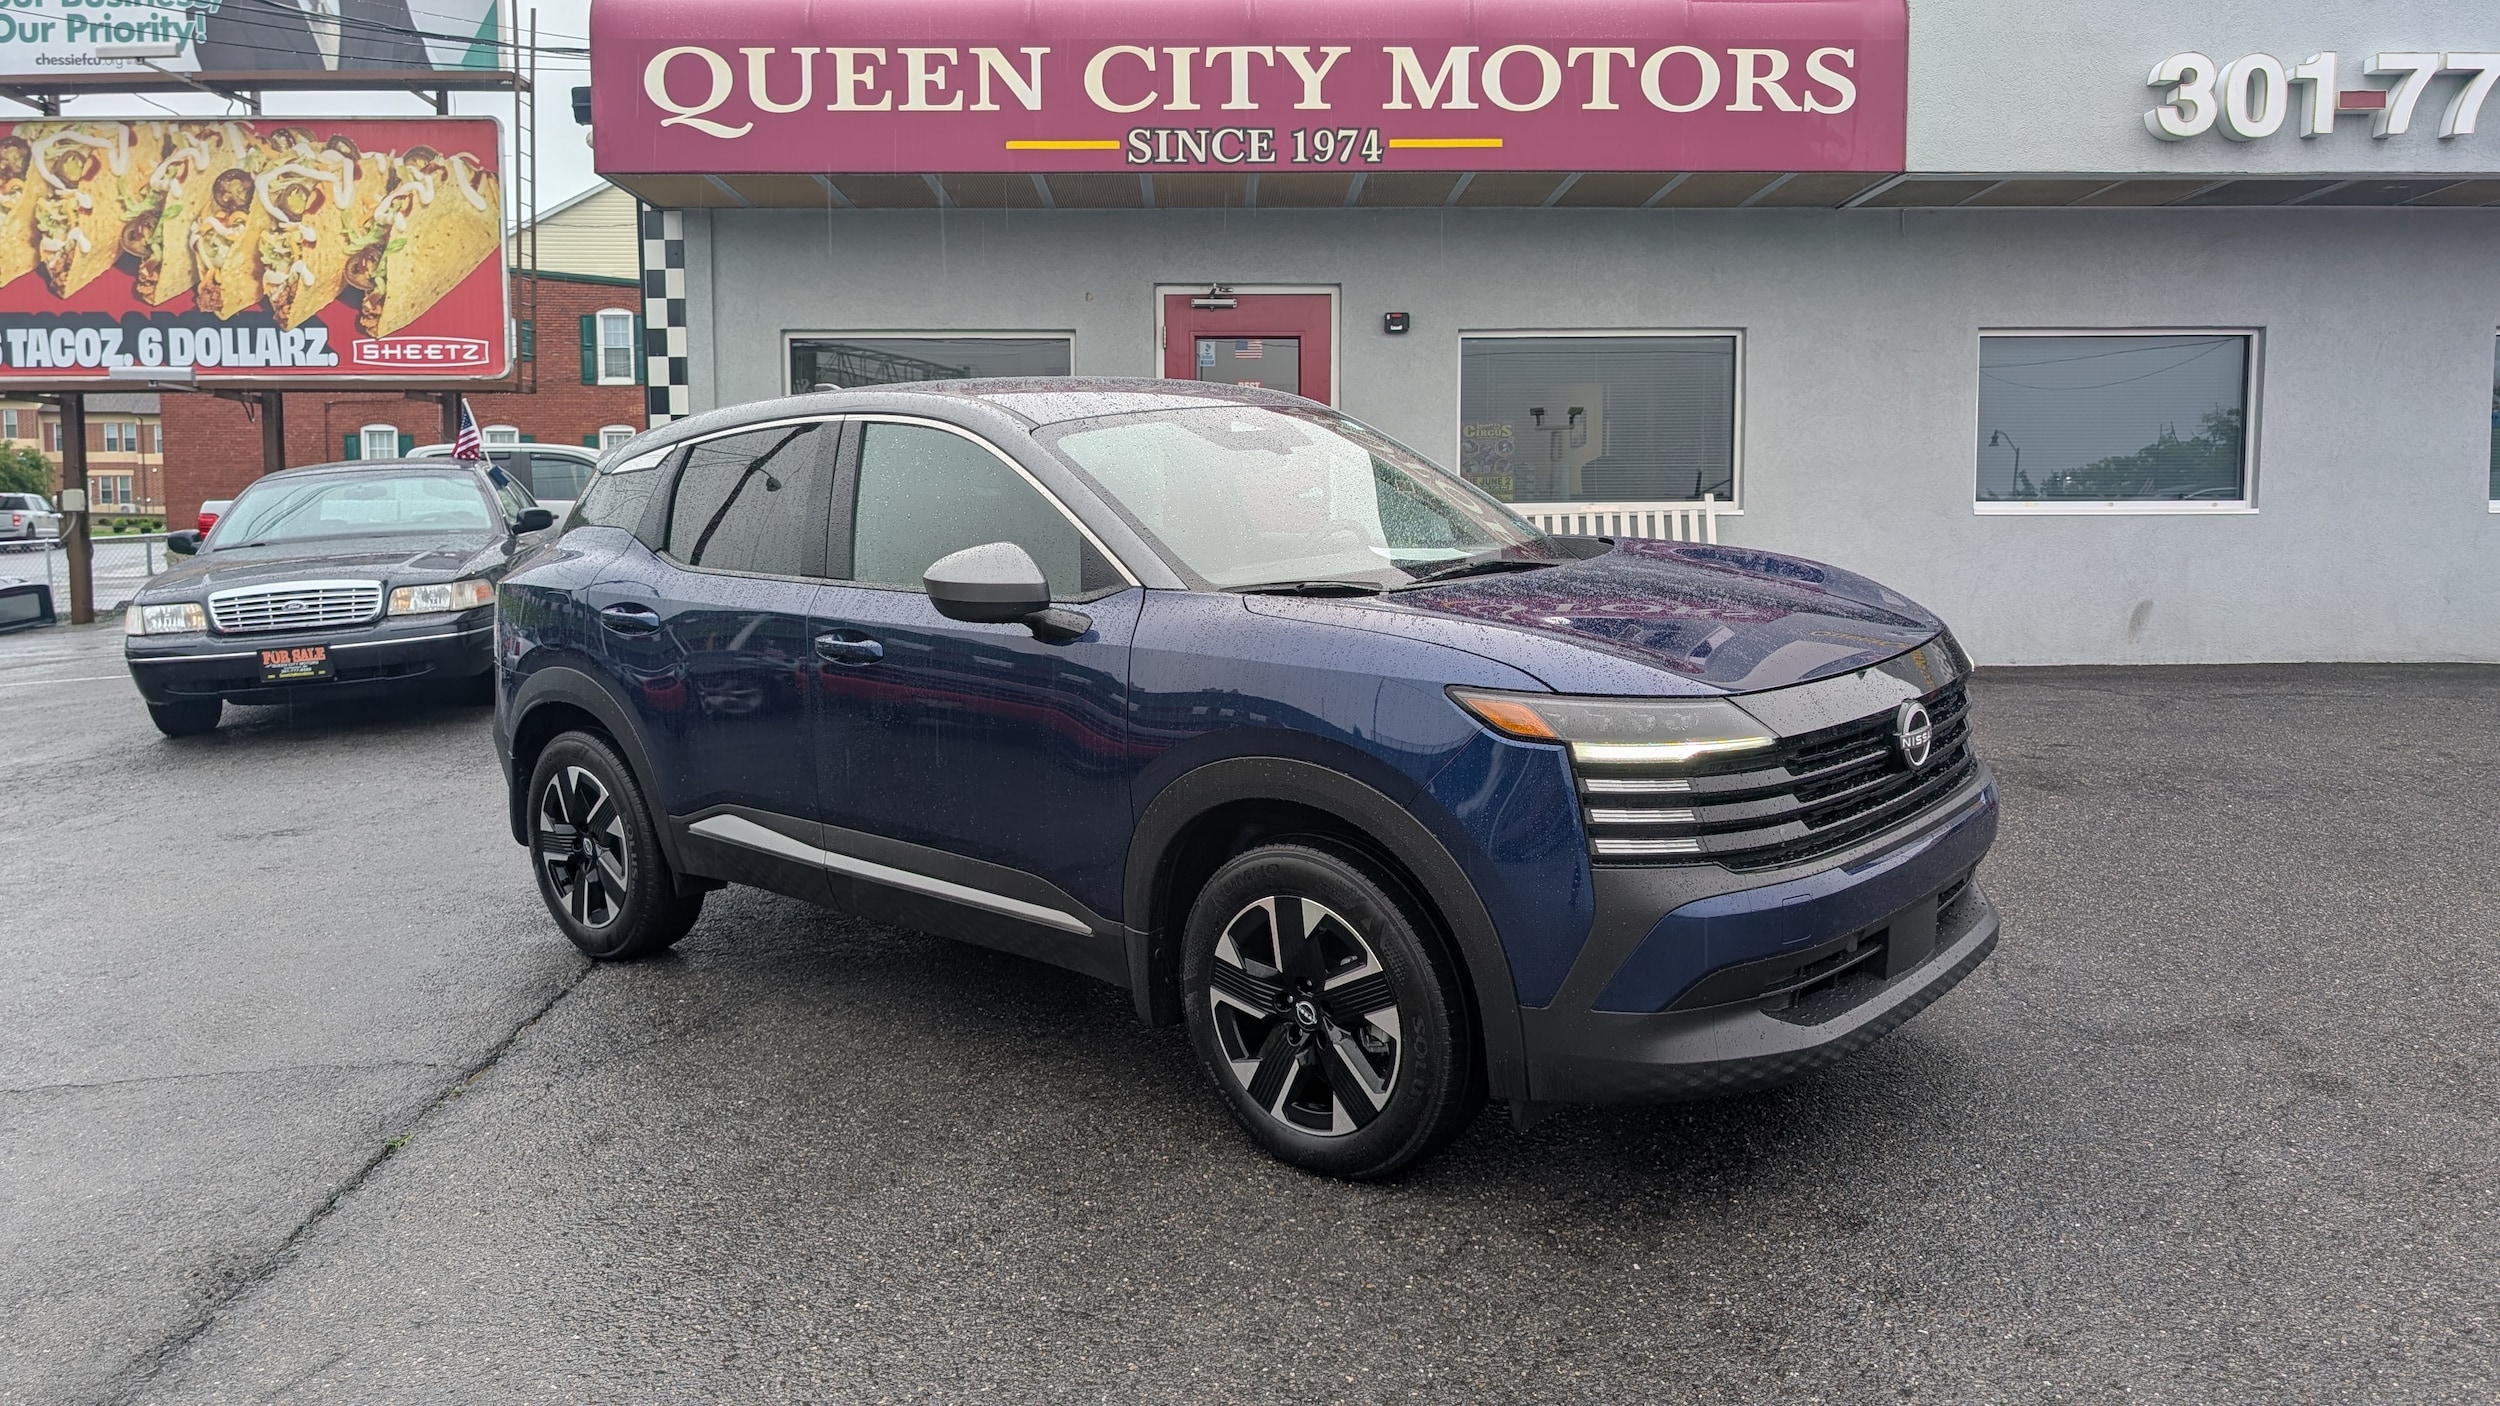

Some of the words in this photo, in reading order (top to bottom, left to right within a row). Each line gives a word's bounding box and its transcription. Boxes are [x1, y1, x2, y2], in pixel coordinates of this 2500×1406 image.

[0, 13, 56, 43] Our
[66, 12, 207, 52] Priority!
[643, 46, 1051, 139] QUEEN
[1083, 45, 1351, 113] CITY
[1382, 44, 1857, 114] MOTORS
[2143, 51, 2500, 142] 301-77
[1126, 126, 1277, 165] SINCE
[1291, 126, 1384, 165] 1974
[6, 327, 135, 368] TACOZ.
[137, 327, 163, 367] 6
[168, 327, 339, 368] DOLLARZ.
[363, 344, 479, 360] SHEETZ
[1463, 424, 1513, 438] CIRCUS
[1480, 477, 1503, 486] JUNE
[1505, 477, 1511, 485] 2
[262, 650, 290, 665] FOR
[292, 647, 326, 662] SALE
[1902, 730, 1930, 748] NISS
